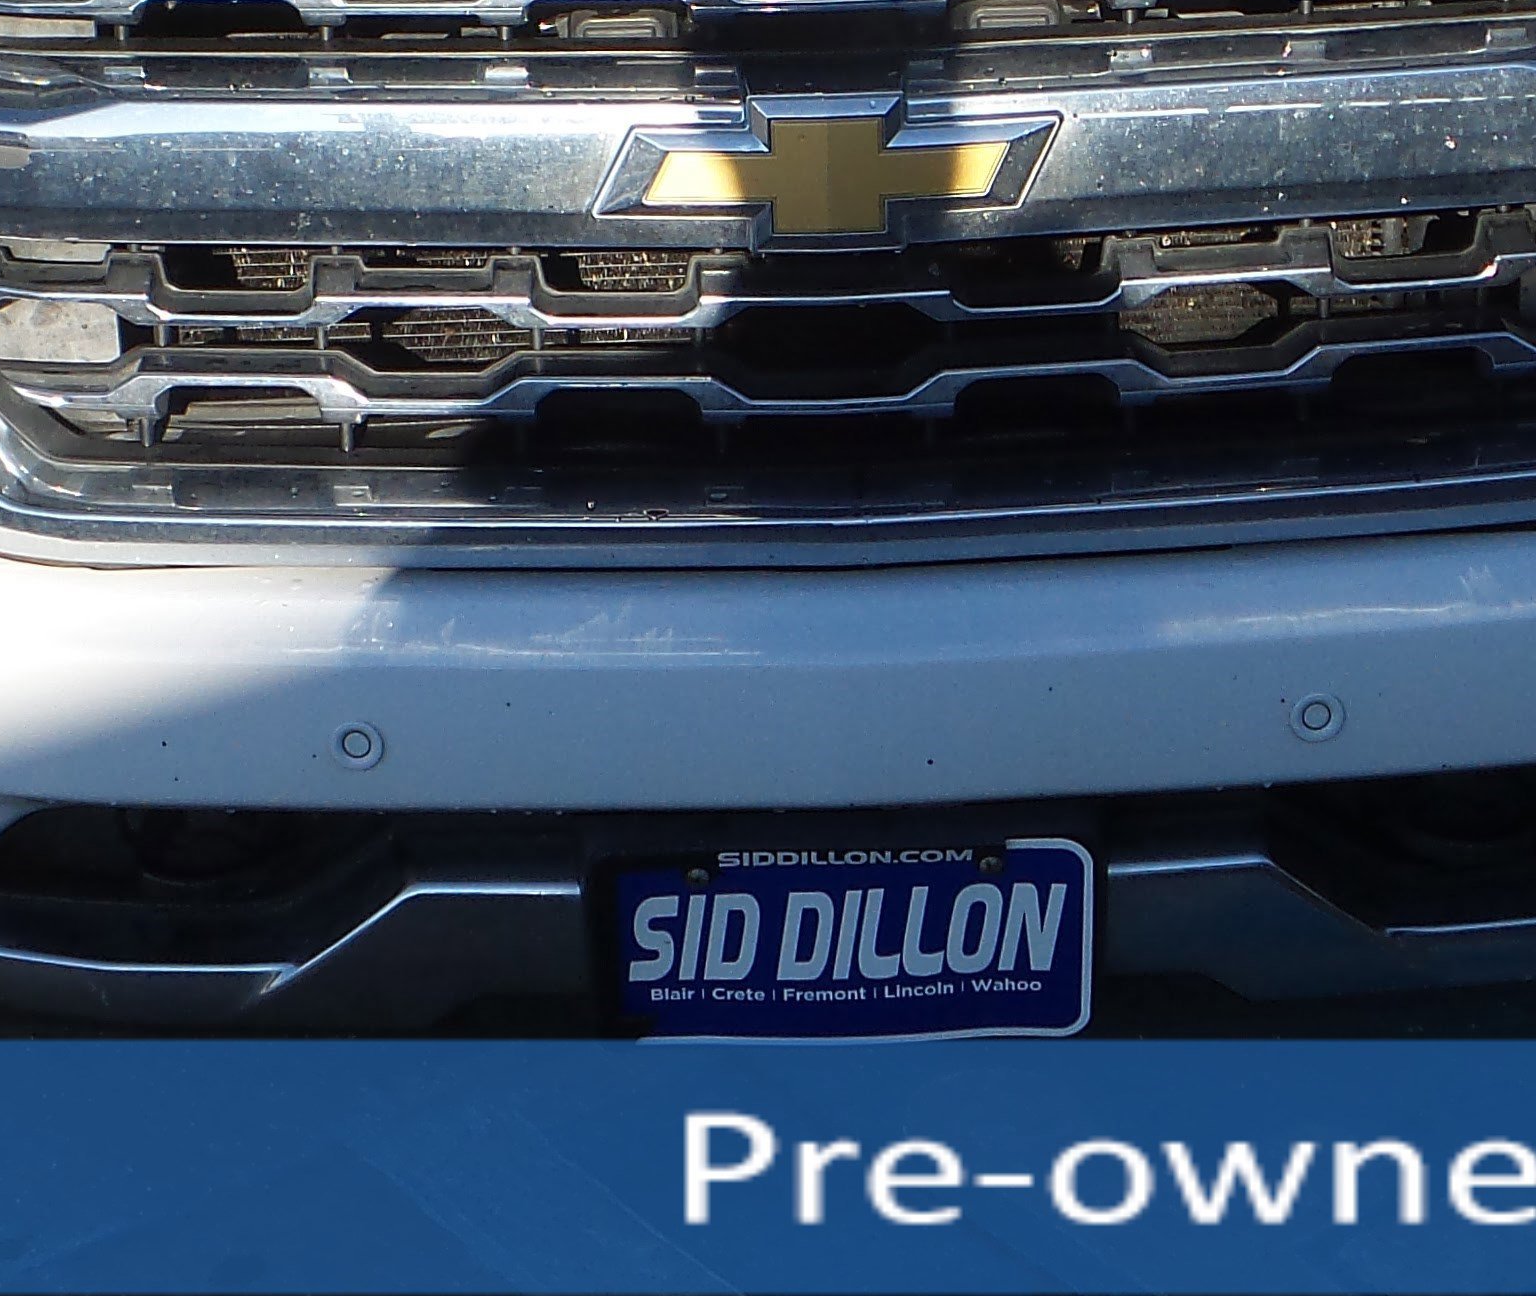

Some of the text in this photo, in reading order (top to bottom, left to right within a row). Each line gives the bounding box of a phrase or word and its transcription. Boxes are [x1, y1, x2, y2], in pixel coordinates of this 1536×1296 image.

[717, 849, 973, 867] SIDDILLON.COM
[628, 882, 1067, 982] SID DILLON
[650, 978, 1042, 1001] Blair Crete Fremont Lincoln Wahoo
